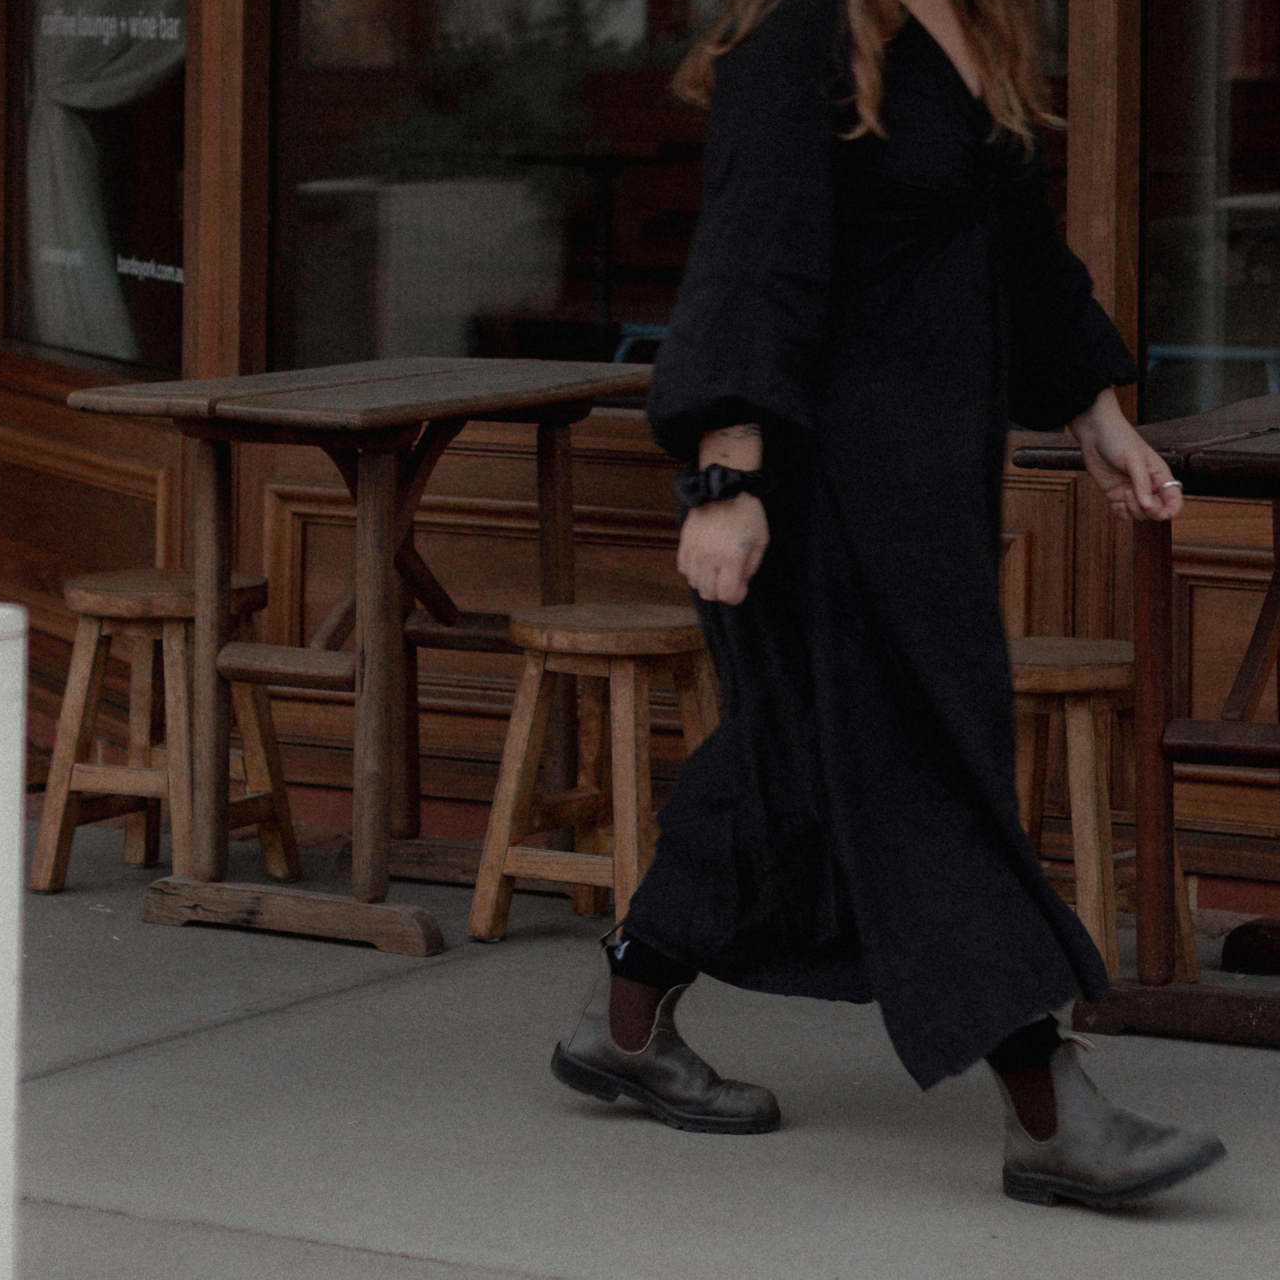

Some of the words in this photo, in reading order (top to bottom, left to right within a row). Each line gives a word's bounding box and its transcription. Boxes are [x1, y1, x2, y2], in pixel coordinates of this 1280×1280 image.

[77, 8, 118, 46] lounge
[129, 9, 158, 40] wine
[159, 9, 181, 41] bar
